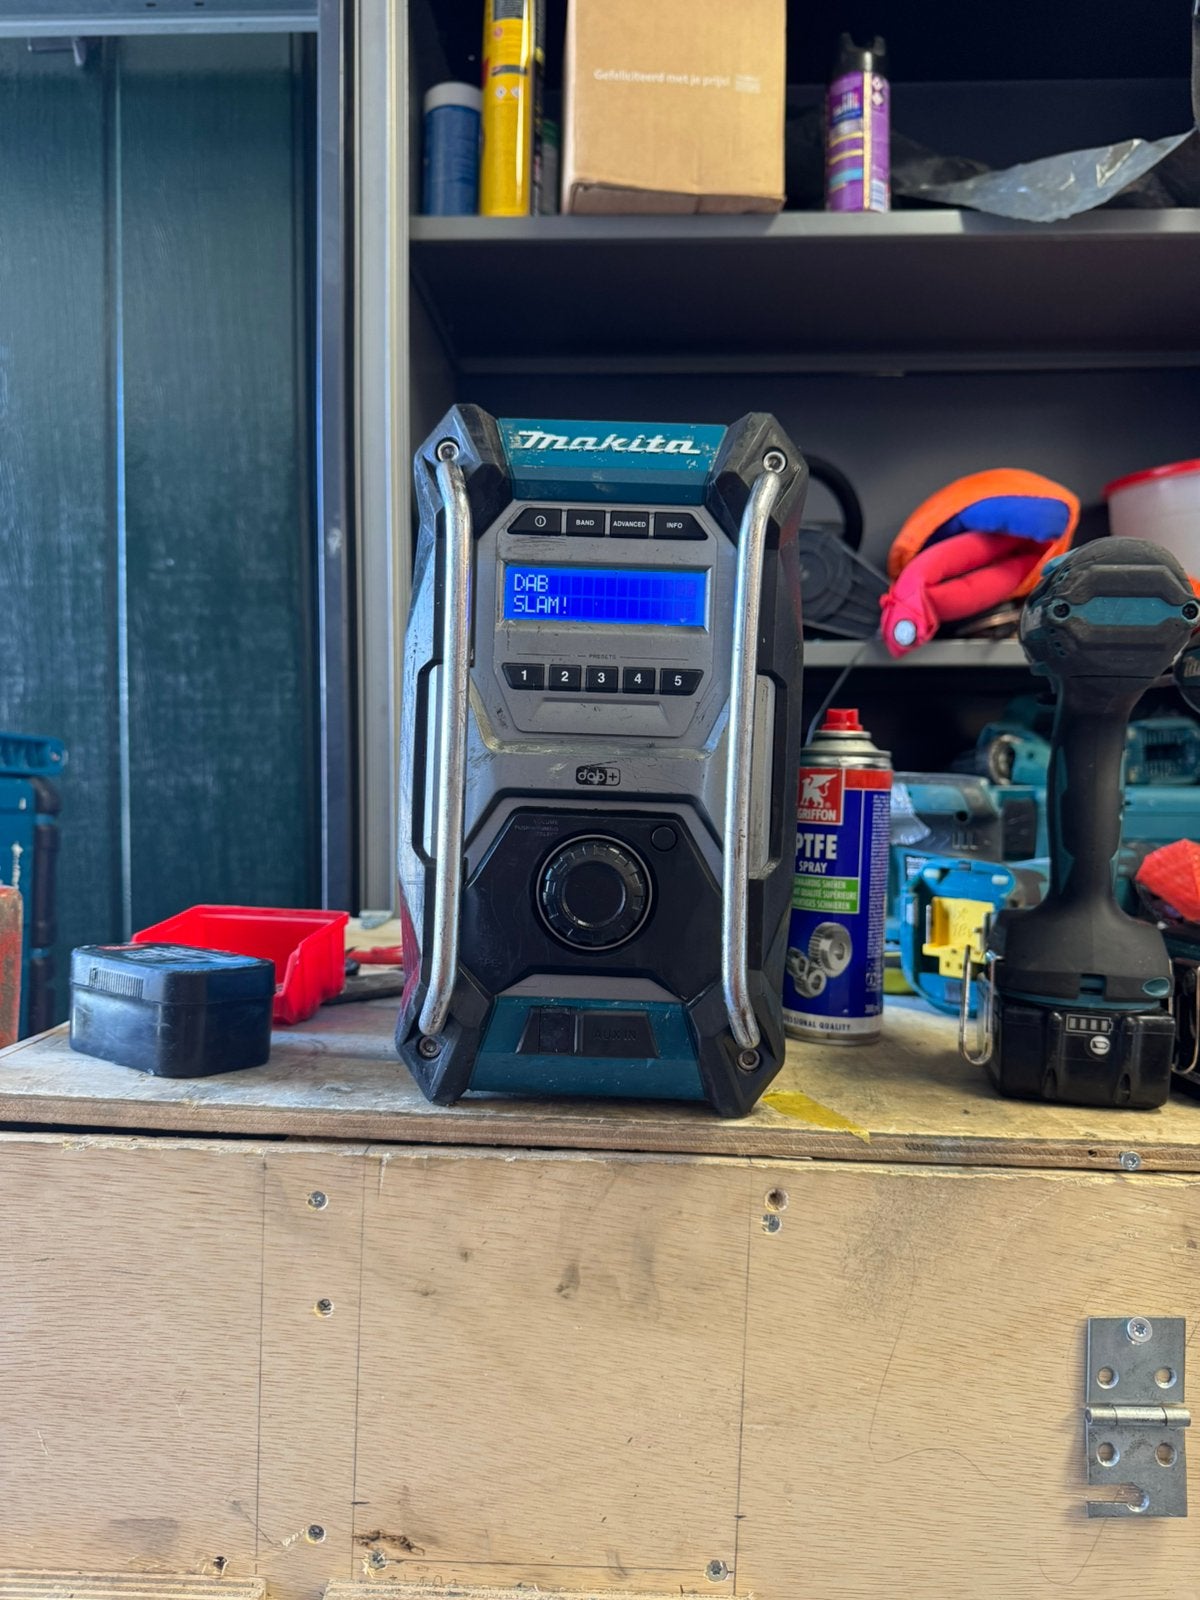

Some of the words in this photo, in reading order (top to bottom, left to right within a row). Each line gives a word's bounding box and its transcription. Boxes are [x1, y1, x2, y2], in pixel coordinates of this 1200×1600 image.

[518, 429, 701, 455] Makita
[575, 519, 595, 527] BAND
[612, 520, 647, 528] ADVANCED
[513, 573, 549, 592] DAB
[513, 595, 567, 615] SLAM!
[521, 669, 528, 681] 1
[560, 670, 569, 682] 2
[597, 672, 606, 683] 3
[634, 672, 642, 684] 4
[674, 675, 682, 686] 5
[797, 808, 837, 822] GRIFFON
[799, 860, 828, 874] SPRAY
[818, 1021, 850, 1031] QUALITY
